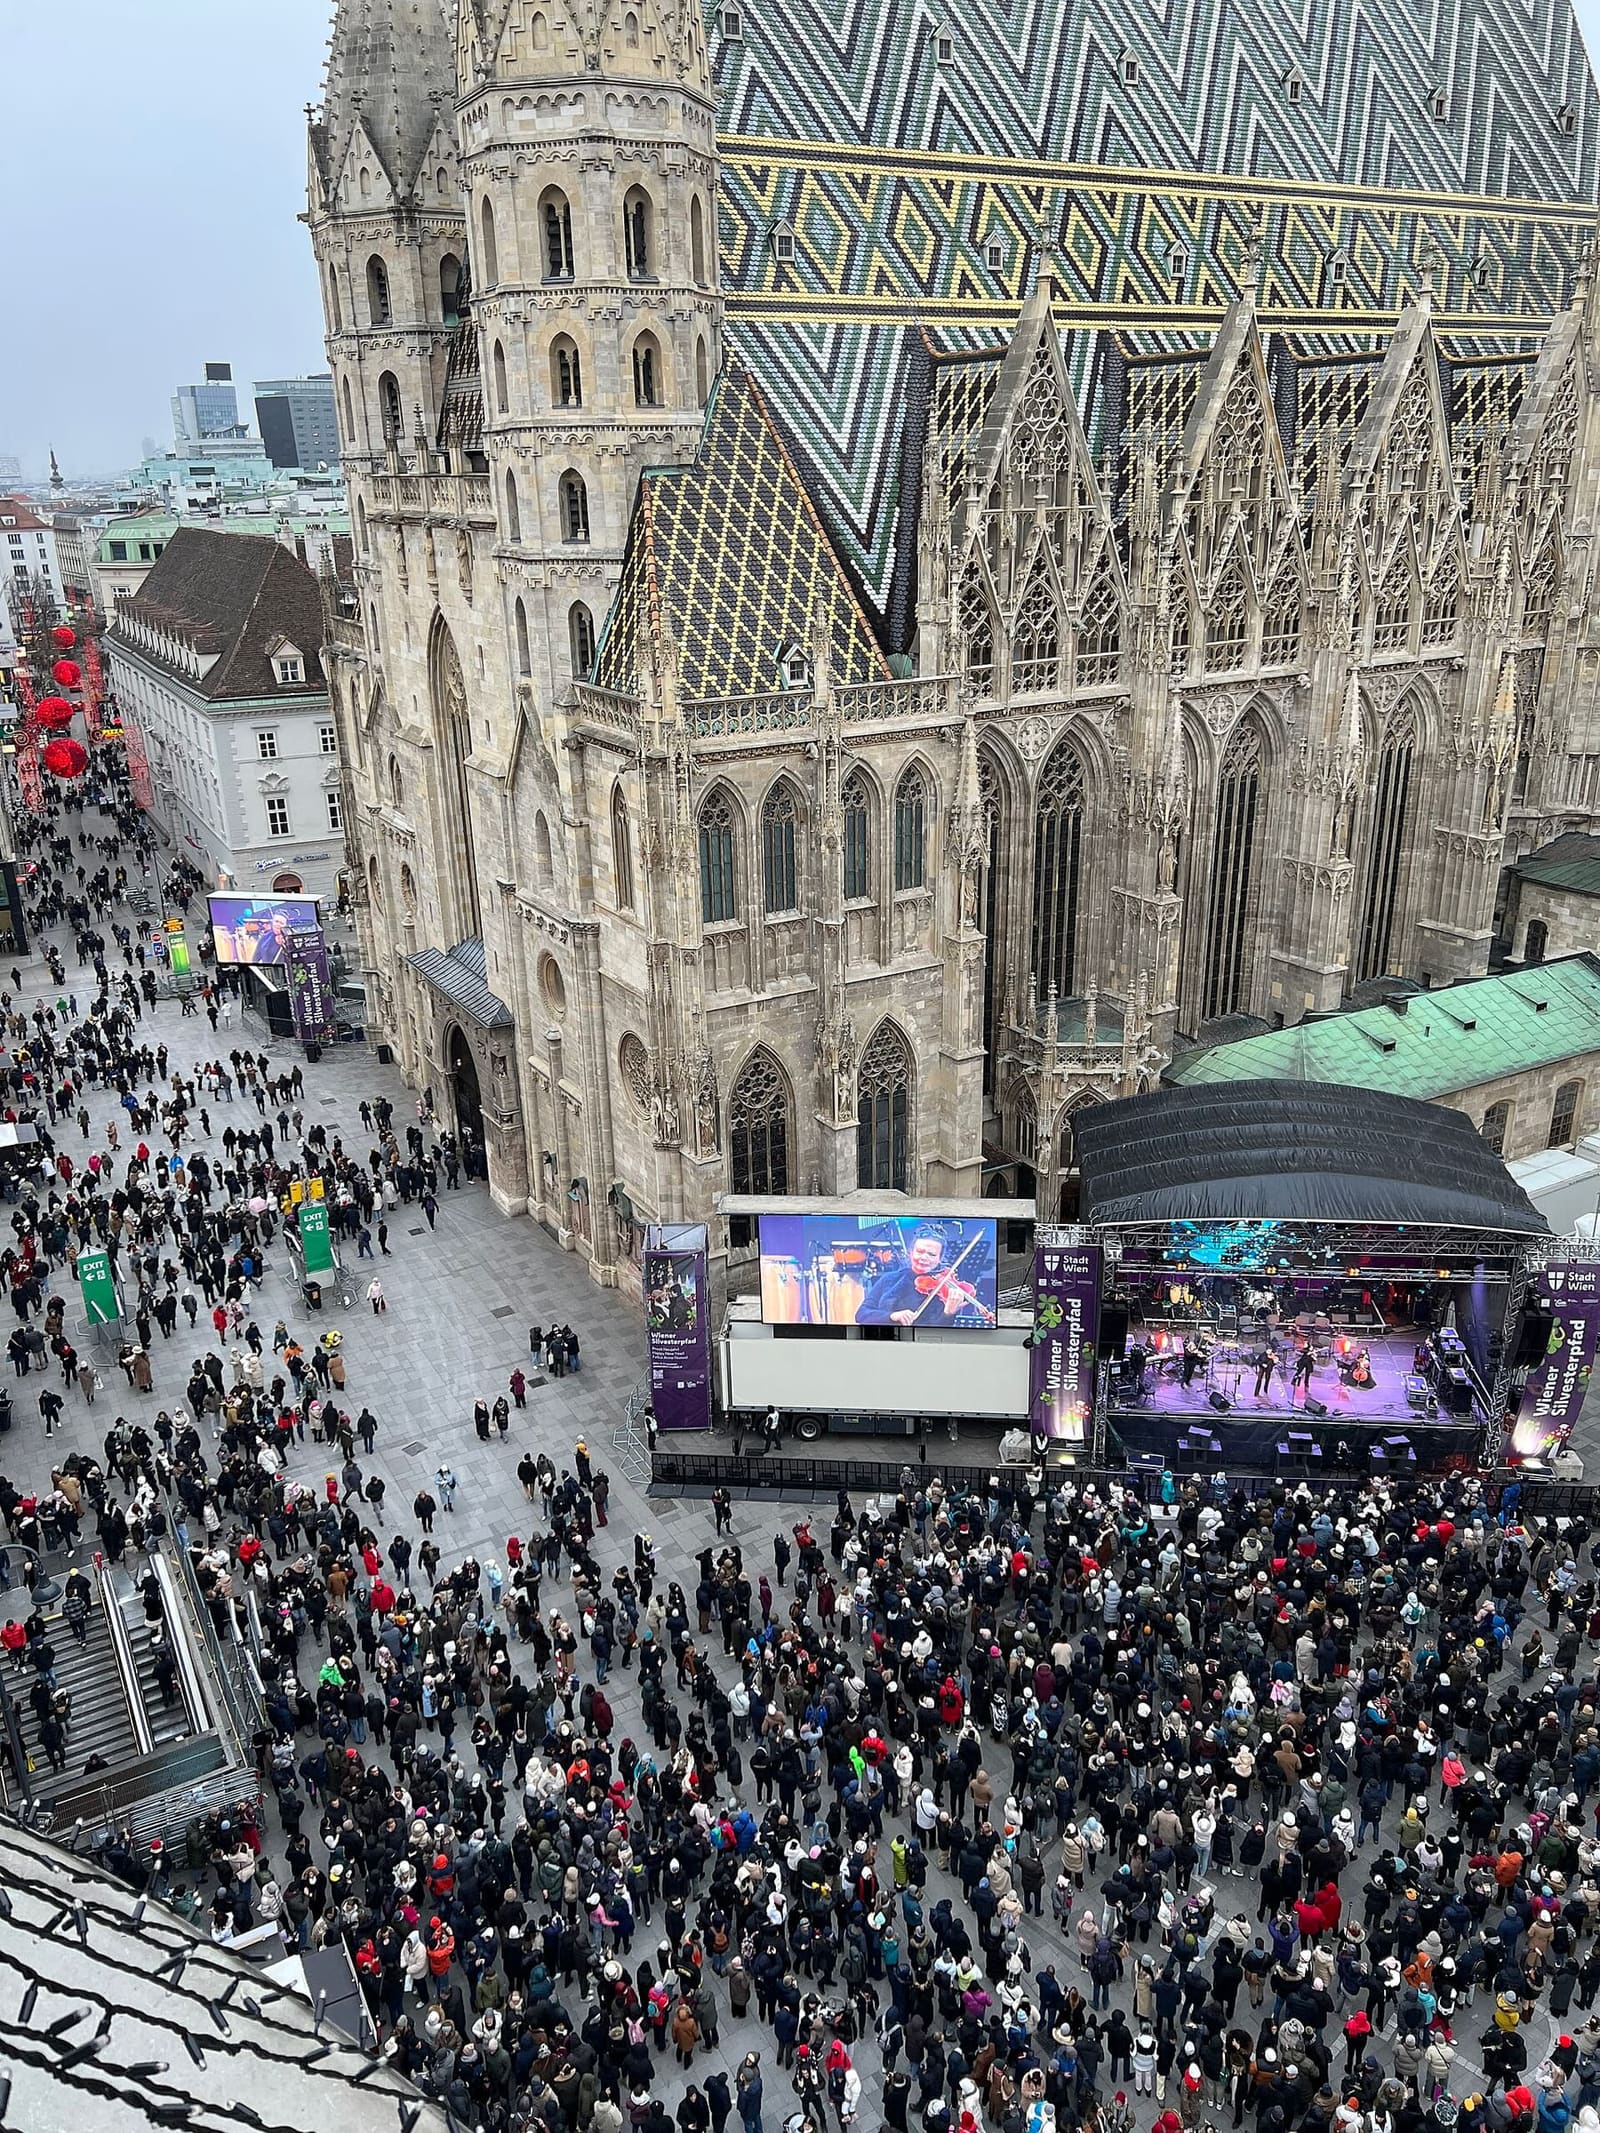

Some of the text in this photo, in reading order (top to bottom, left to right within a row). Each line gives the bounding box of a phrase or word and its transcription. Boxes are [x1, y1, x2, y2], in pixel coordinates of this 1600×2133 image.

[307, 962, 324, 1025] Silvesterpfad
[303, 991, 314, 1026] Wiener
[303, 1212, 323, 1222] EXIT
[83, 1260, 105, 1271] EXIT
[1063, 1255, 1089, 1265] Stadt
[1063, 1264, 1089, 1273] Wien
[1568, 1271, 1596, 1282] Stadt
[1568, 1281, 1595, 1291] Wien
[651, 1337, 697, 1346] Silvesterpfad
[1063, 1298, 1085, 1392] Silvesterpfad
[1046, 1339, 1062, 1390] Wiener
[1551, 1319, 1586, 1416] Silvesterpfad
[1533, 1365, 1560, 1417] Wiener
